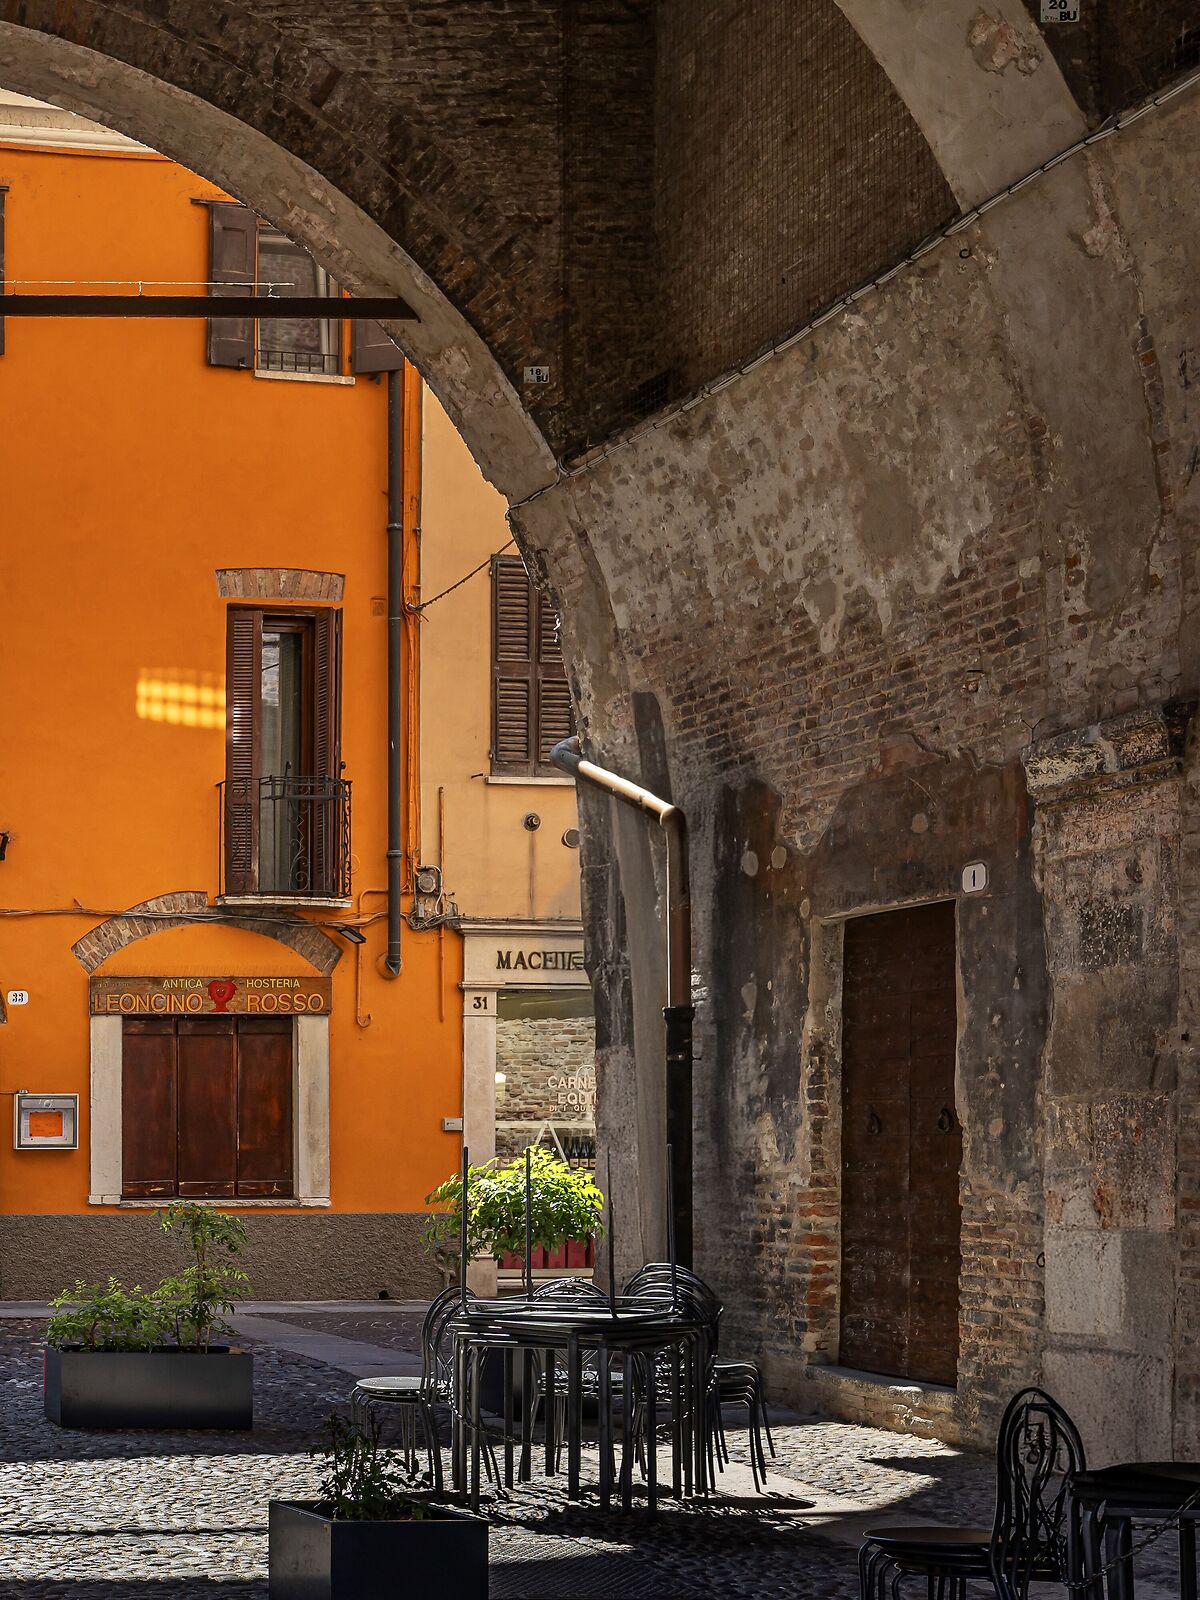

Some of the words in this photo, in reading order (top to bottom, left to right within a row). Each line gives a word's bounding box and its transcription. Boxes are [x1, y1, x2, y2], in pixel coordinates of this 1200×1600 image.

[1048, 0, 1068, 10] 20
[1059, 10, 1077, 21] BU
[529, 368, 542, 376] 18
[536, 375, 548, 383] BU
[162, 978, 203, 989] ANTICA
[246, 978, 301, 989] HOSTERIA
[12, 992, 24, 1003] 33
[94, 993, 203, 1012] LEONCINO
[247, 993, 324, 1012] ROSSO
[472, 996, 488, 1010] 31
